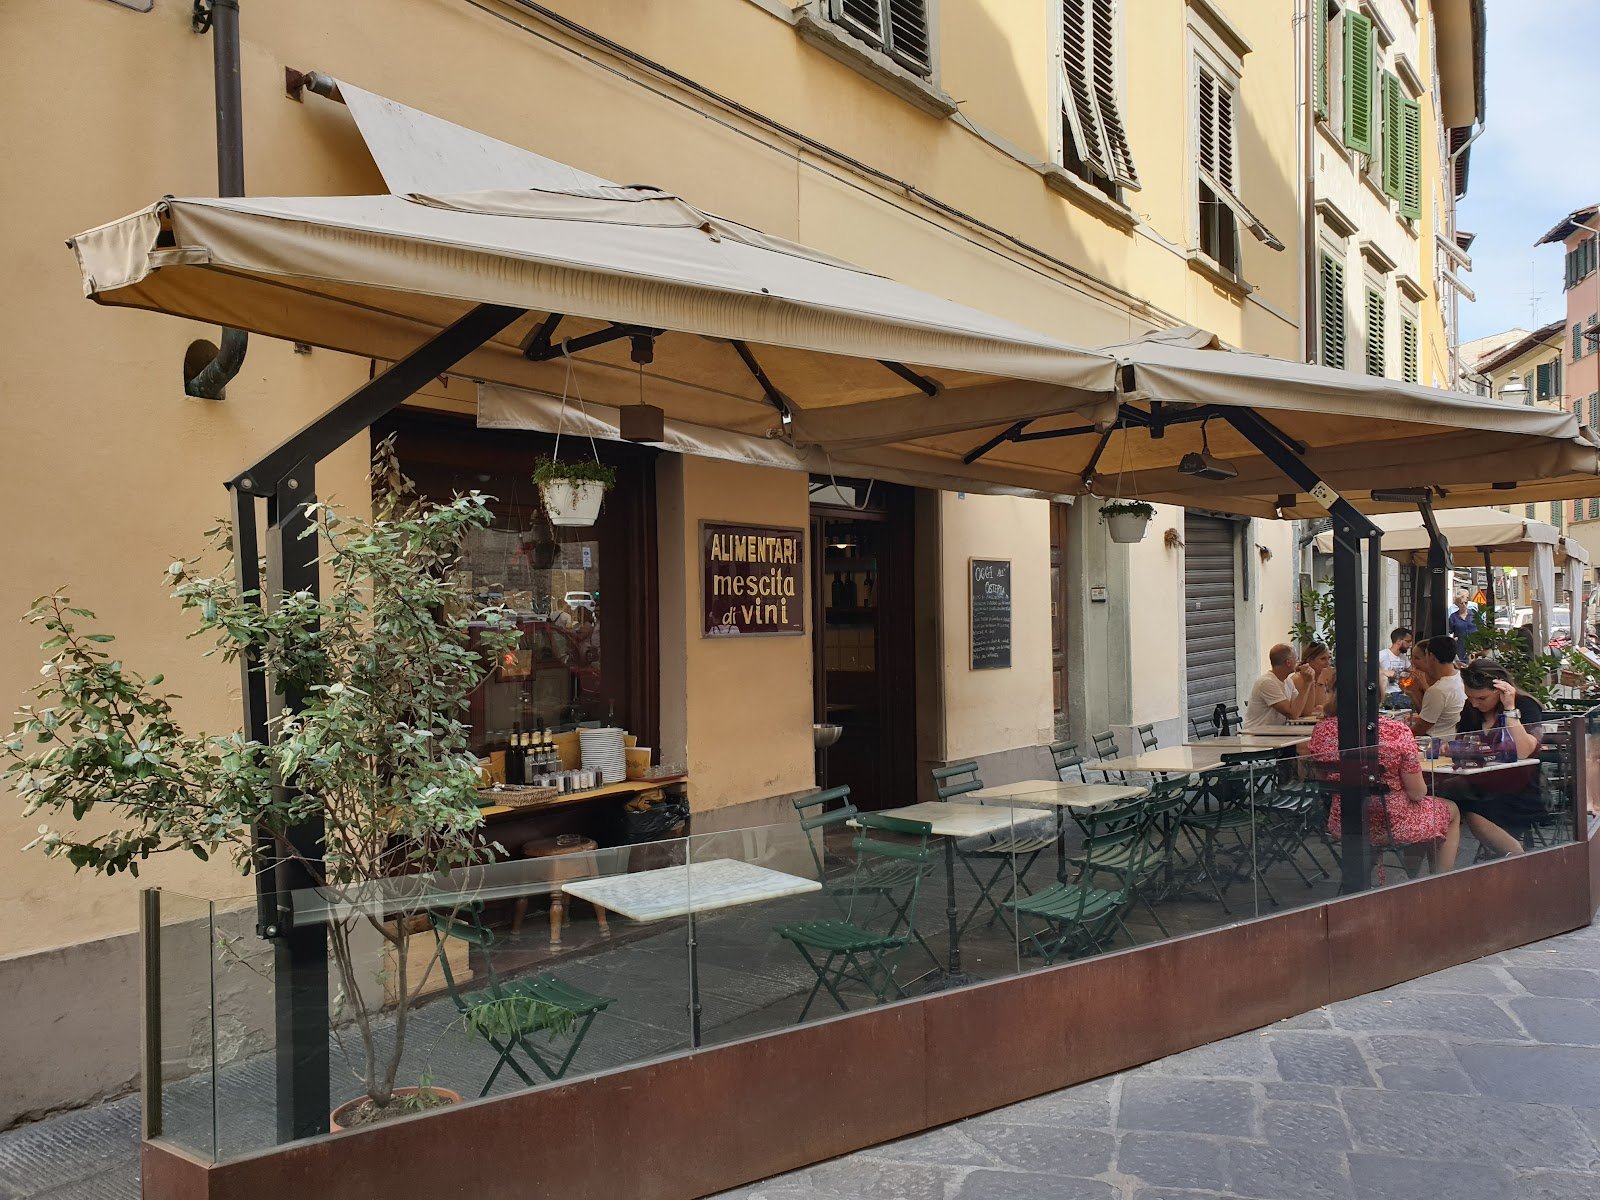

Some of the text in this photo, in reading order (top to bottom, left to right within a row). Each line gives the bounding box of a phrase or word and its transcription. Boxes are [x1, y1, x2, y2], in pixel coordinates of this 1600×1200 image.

[711, 533, 797, 564] ALIMENTARI
[713, 567, 795, 596] mescita
[975, 565, 994, 581] OGGI
[722, 597, 789, 625] di vini
